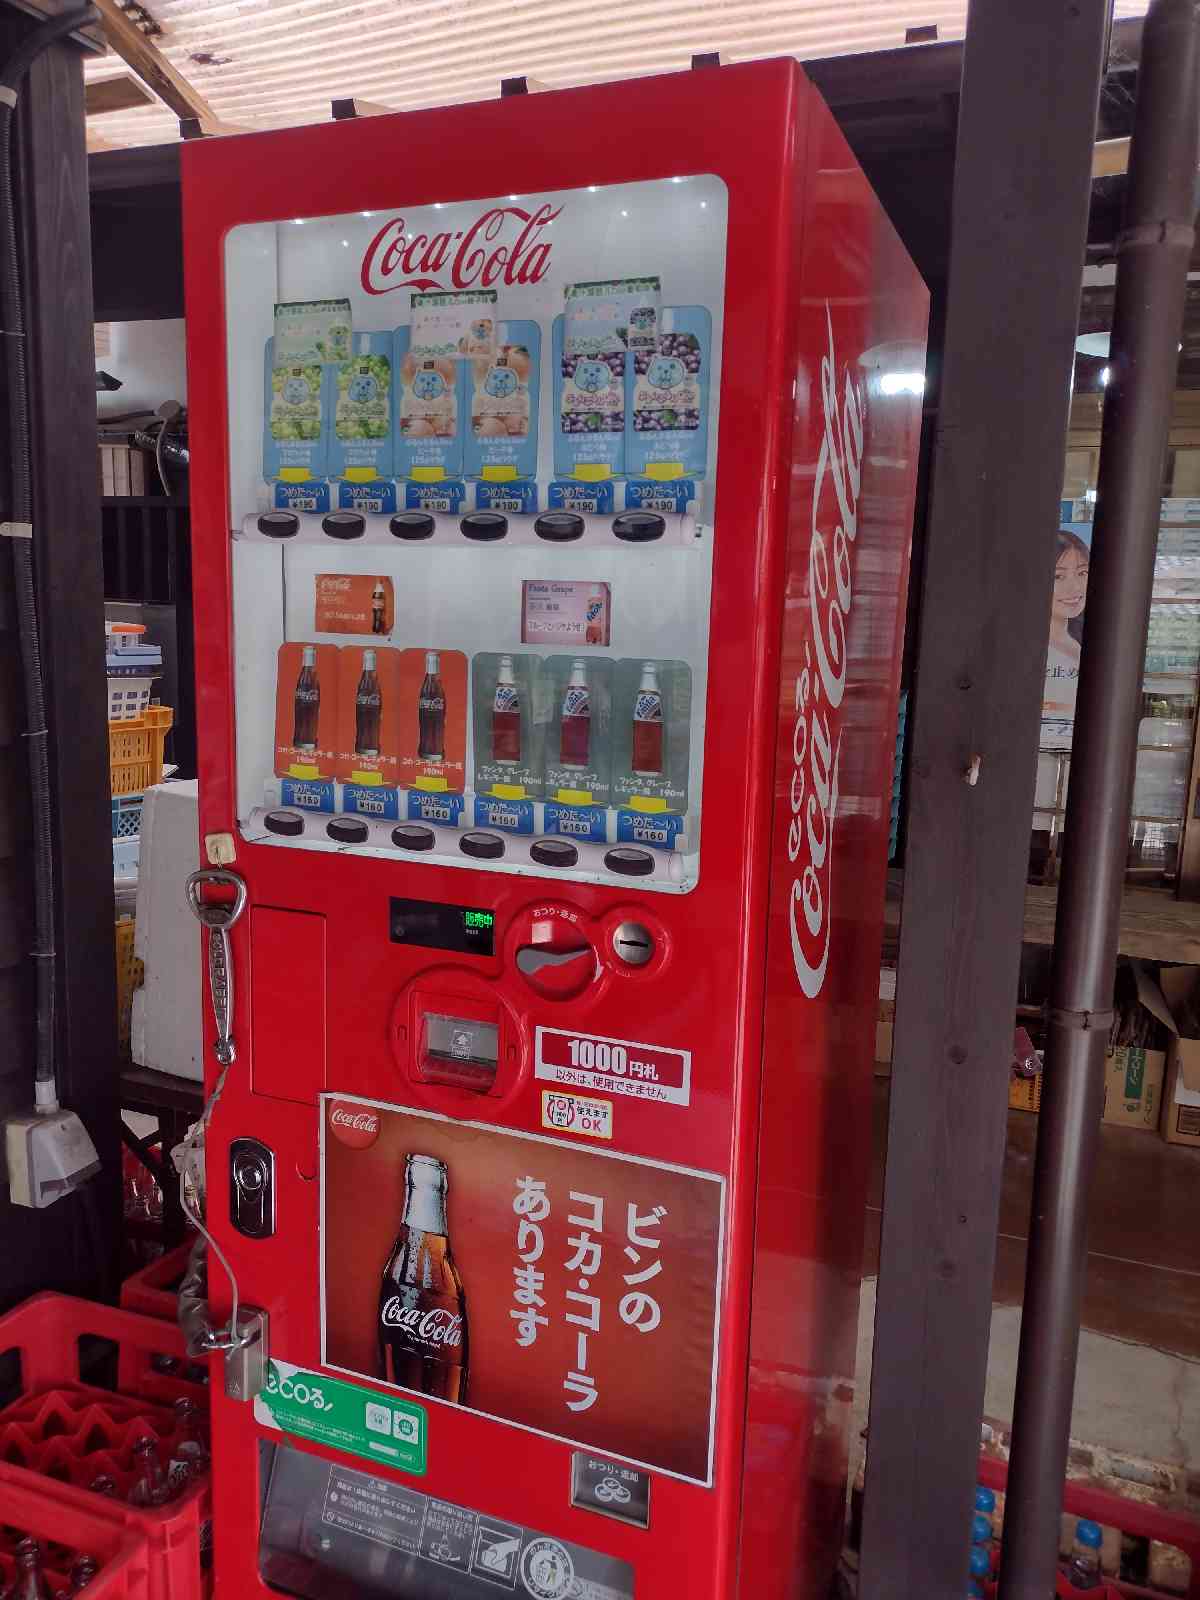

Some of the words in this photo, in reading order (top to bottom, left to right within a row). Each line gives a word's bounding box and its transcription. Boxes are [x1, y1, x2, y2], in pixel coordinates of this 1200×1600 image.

[361, 203, 566, 295] Coca-Cola
[568, 501, 594, 511] ¥190
[645, 500, 673, 510] ¥190
[789, 297, 864, 998] Coca-Cola
[424, 808, 449, 818] ¥160
[561, 822, 589, 833] ¥160
[636, 829, 665, 841] ¥160
[464, 910, 494, 929] 販売中
[331, 1108, 378, 1133] Coca-Cola
[581, 1117, 603, 1132] OK
[509, 1175, 551, 1348] あります
[618, 1202, 670, 1333] ビンの
[563, 1190, 604, 1413] コカ・コーラ
[381, 1295, 463, 1347] Coca-Cola
